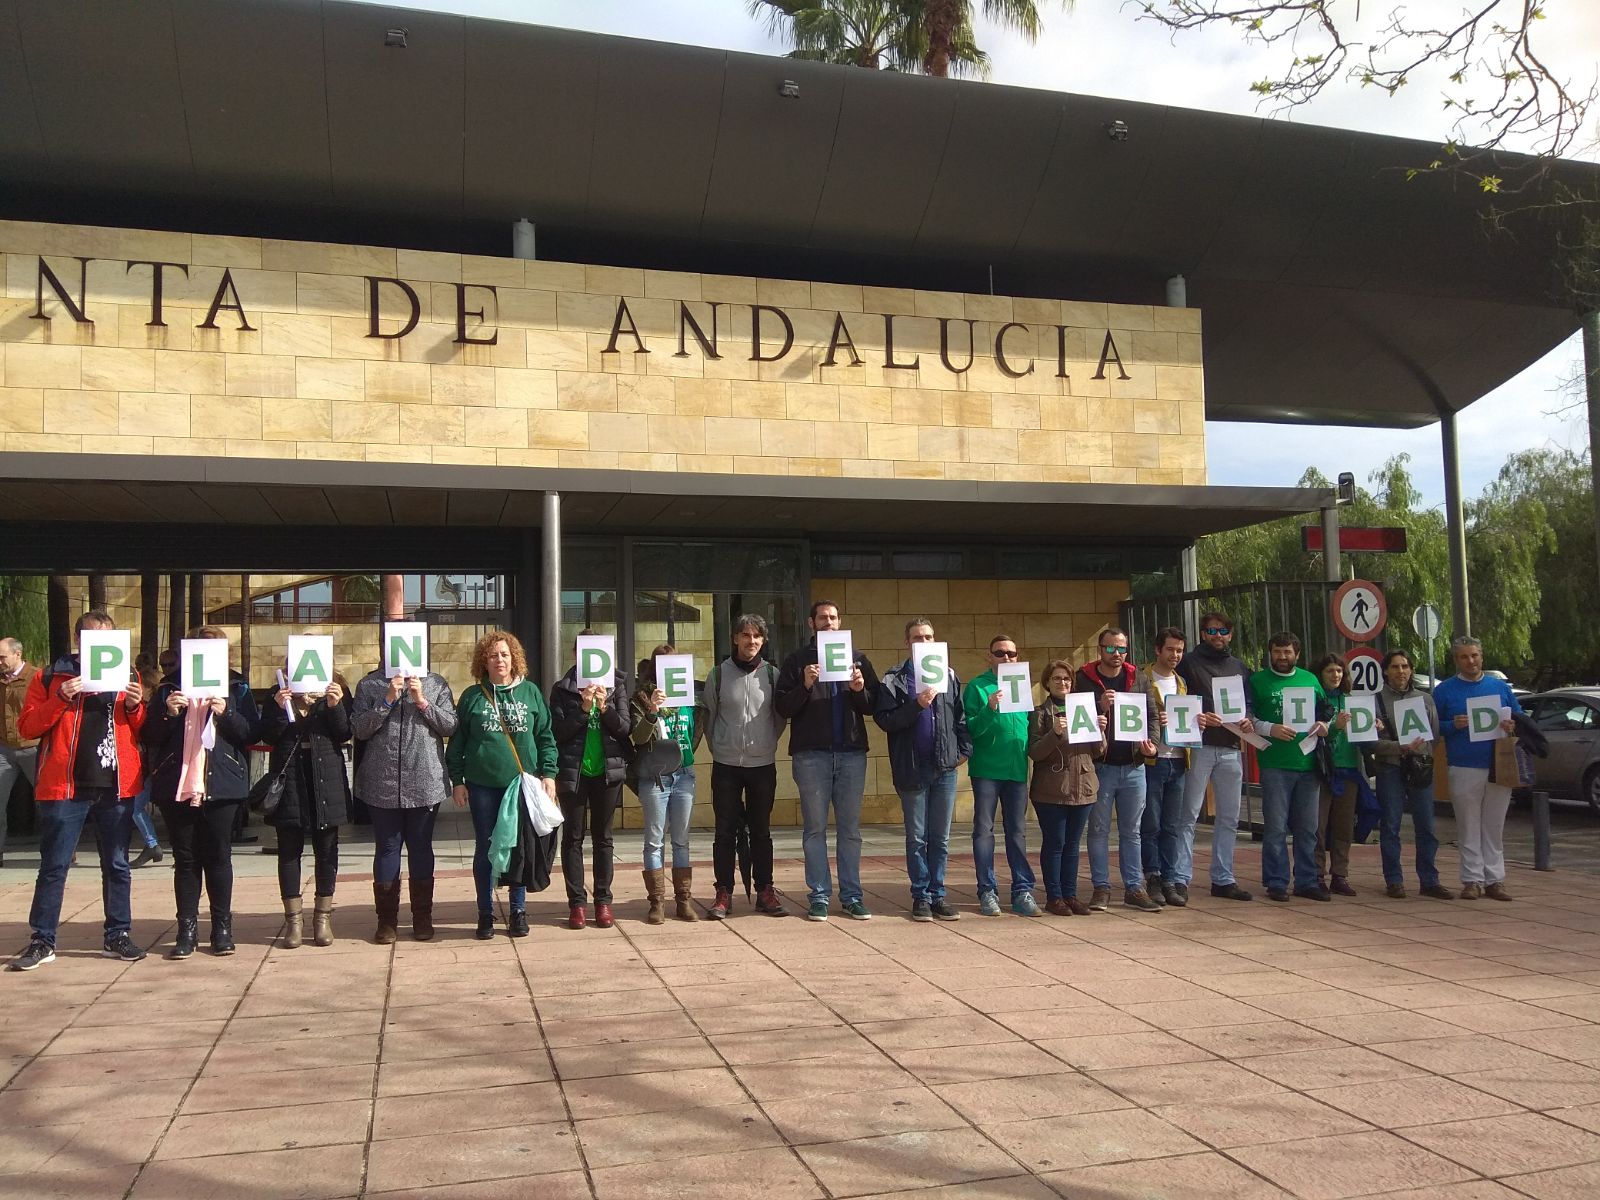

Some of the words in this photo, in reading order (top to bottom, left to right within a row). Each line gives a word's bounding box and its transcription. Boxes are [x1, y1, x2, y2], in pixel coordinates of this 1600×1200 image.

[364, 276, 499, 345] DE
[600, 296, 1131, 380] ANDALUCIA
[1351, 661, 1379, 692] 20
